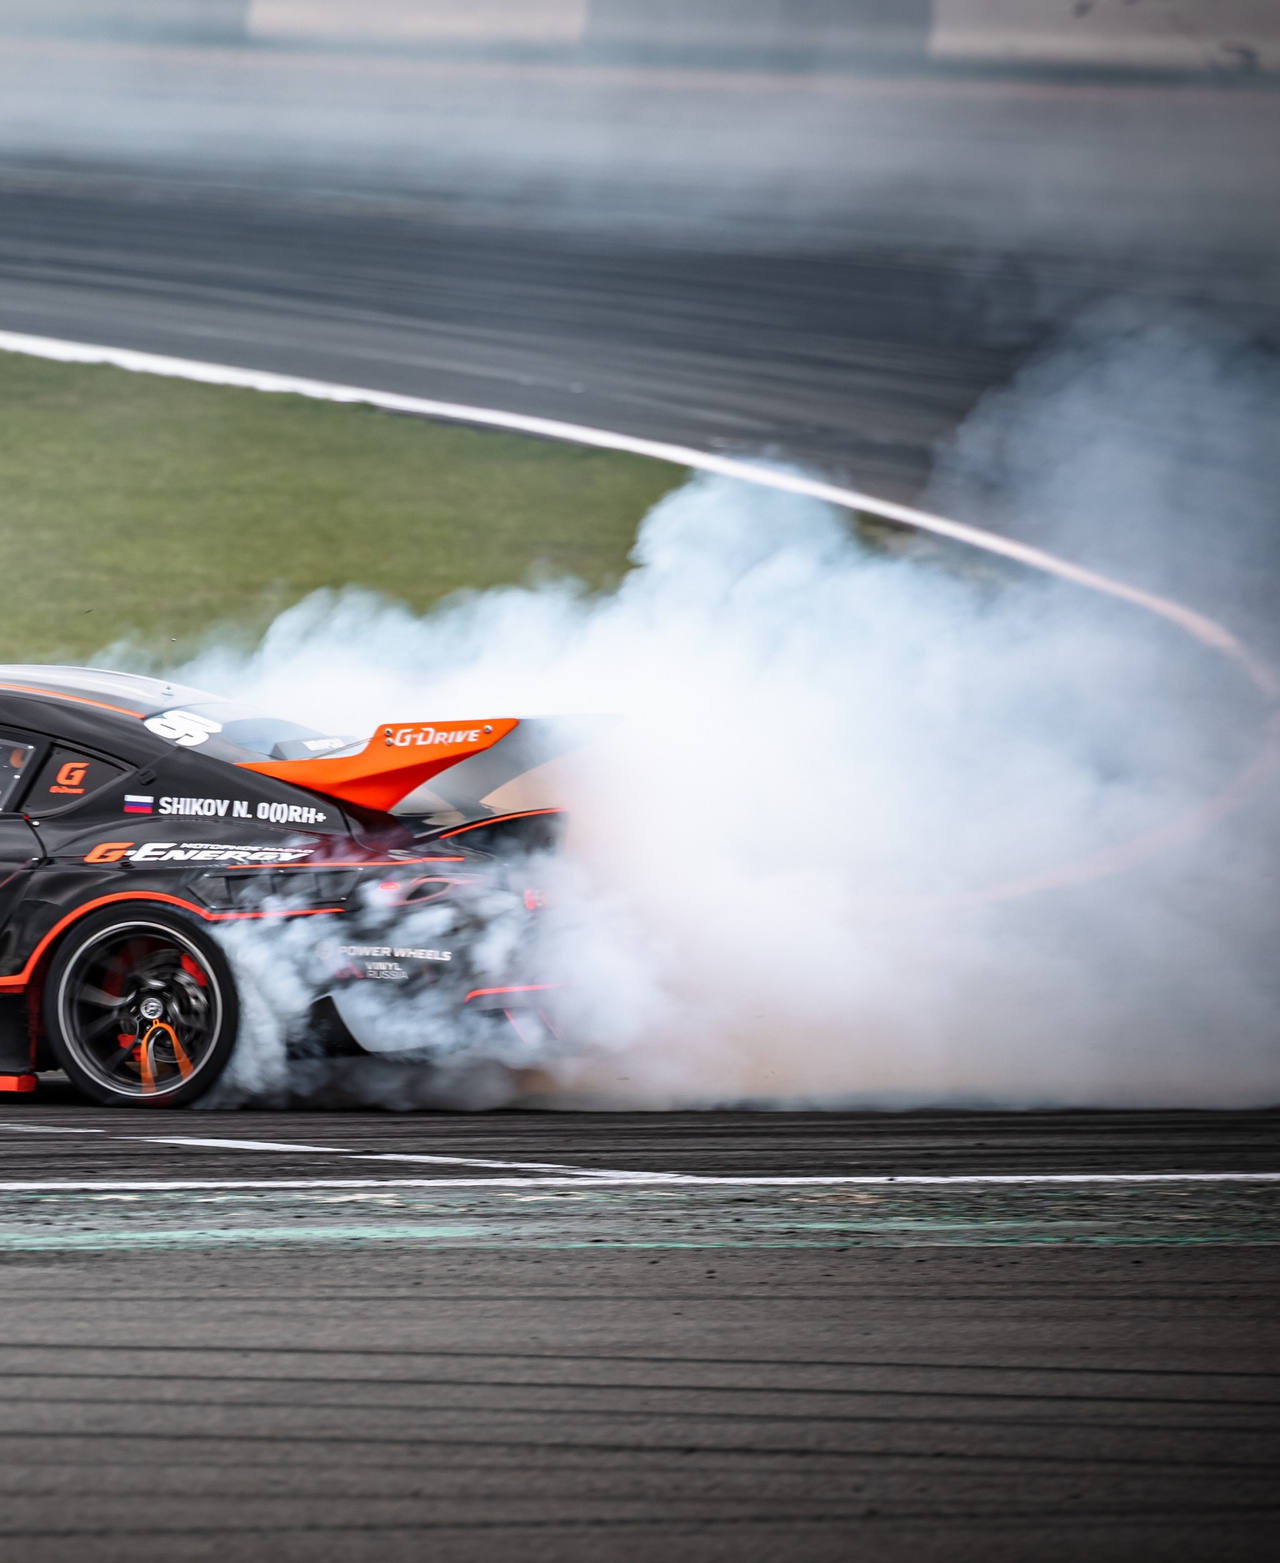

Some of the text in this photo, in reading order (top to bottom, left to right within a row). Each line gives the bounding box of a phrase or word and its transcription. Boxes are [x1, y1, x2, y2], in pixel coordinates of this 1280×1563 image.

[158, 796, 230, 817] SHIKOV
[232, 801, 253, 819] N.
[83, 842, 312, 863] G-ENERGY
[340, 945, 452, 961] POWER WHEELS
[365, 961, 402, 971] VINYL
[366, 970, 409, 980] RUSSIA
